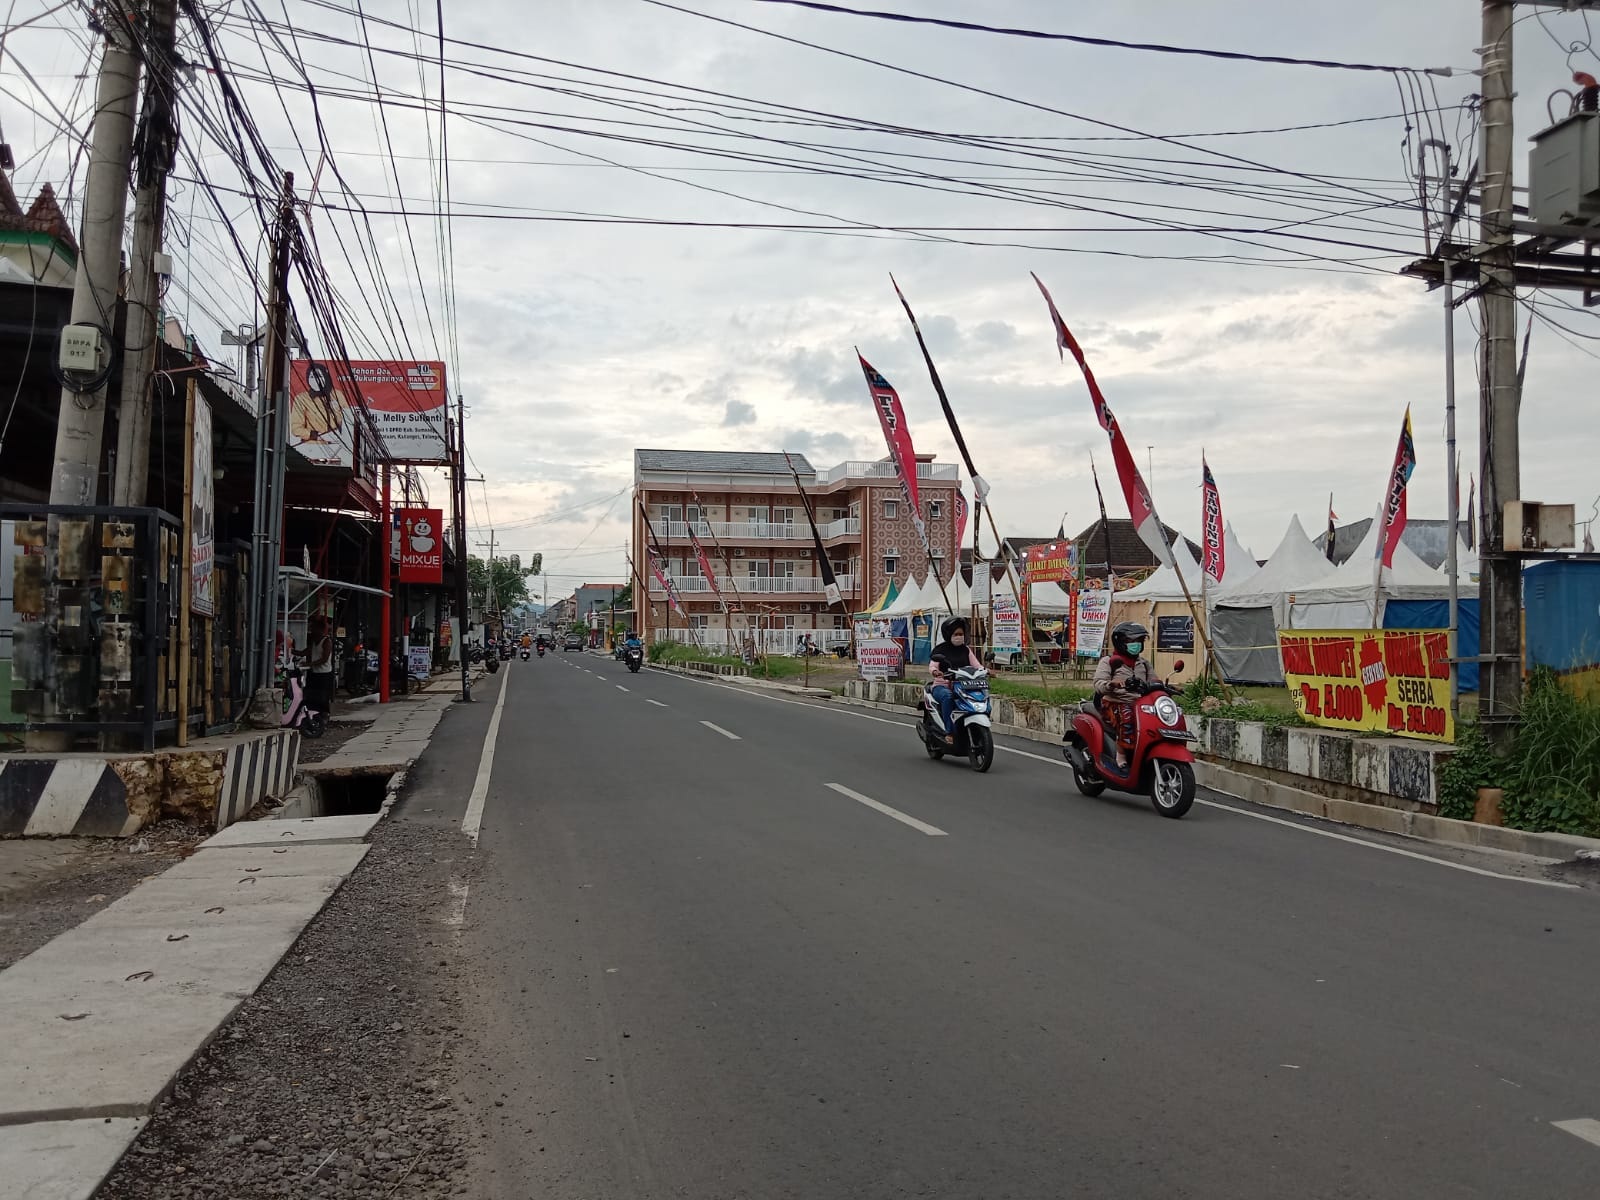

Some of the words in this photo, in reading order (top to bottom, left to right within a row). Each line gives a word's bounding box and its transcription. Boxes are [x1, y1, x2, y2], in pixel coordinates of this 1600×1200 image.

[418, 364, 429, 374] 10
[383, 413, 406, 423] Melly
[402, 554, 440, 565] MIXUE
[1081, 612, 1107, 620] UMKM
[1397, 678, 1435, 705] SERBA
[1324, 684, 1363, 722] 5.000
